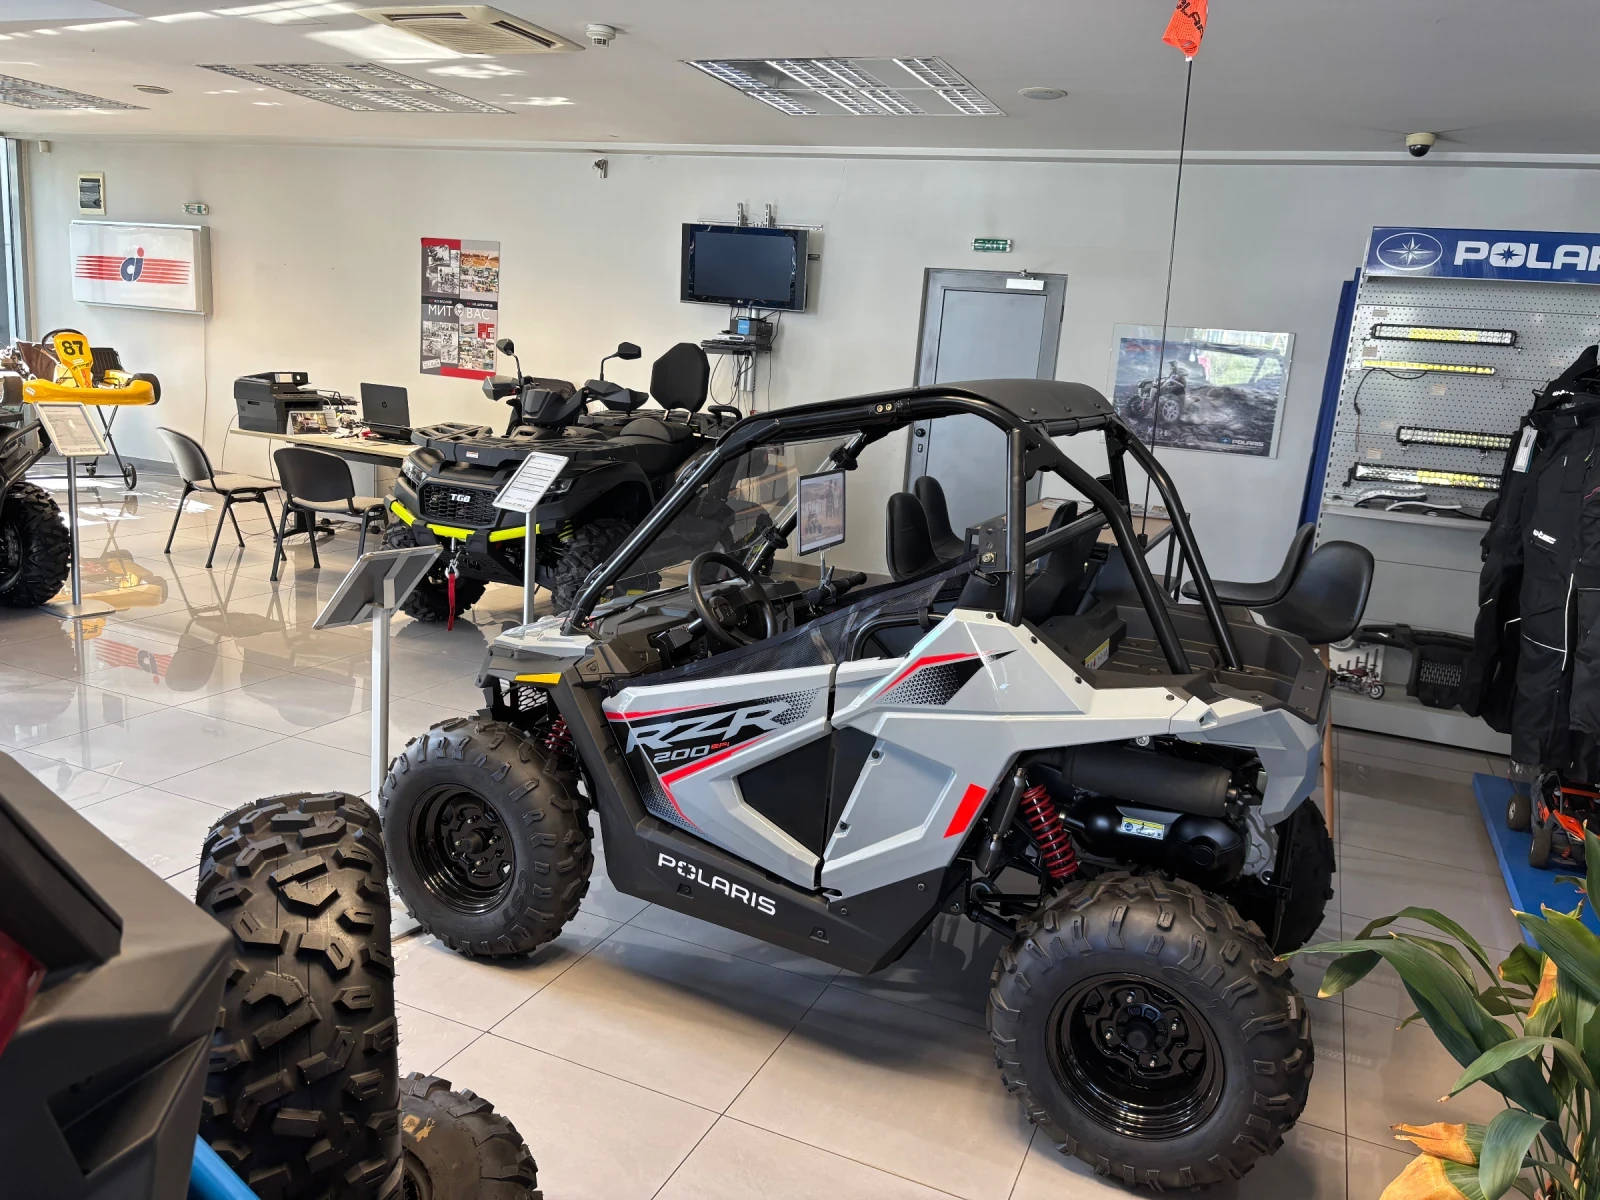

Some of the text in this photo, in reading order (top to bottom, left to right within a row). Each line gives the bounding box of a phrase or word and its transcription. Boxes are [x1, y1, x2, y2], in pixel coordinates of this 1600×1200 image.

[975, 240, 1006, 250] EXIT
[61, 340, 84, 356] 87
[1231, 439, 1264, 447] POLARIS
[450, 493, 471, 503] TGB
[625, 701, 791, 754] RZR
[653, 744, 710, 763] 200
[657, 852, 776, 916] POLARIS
